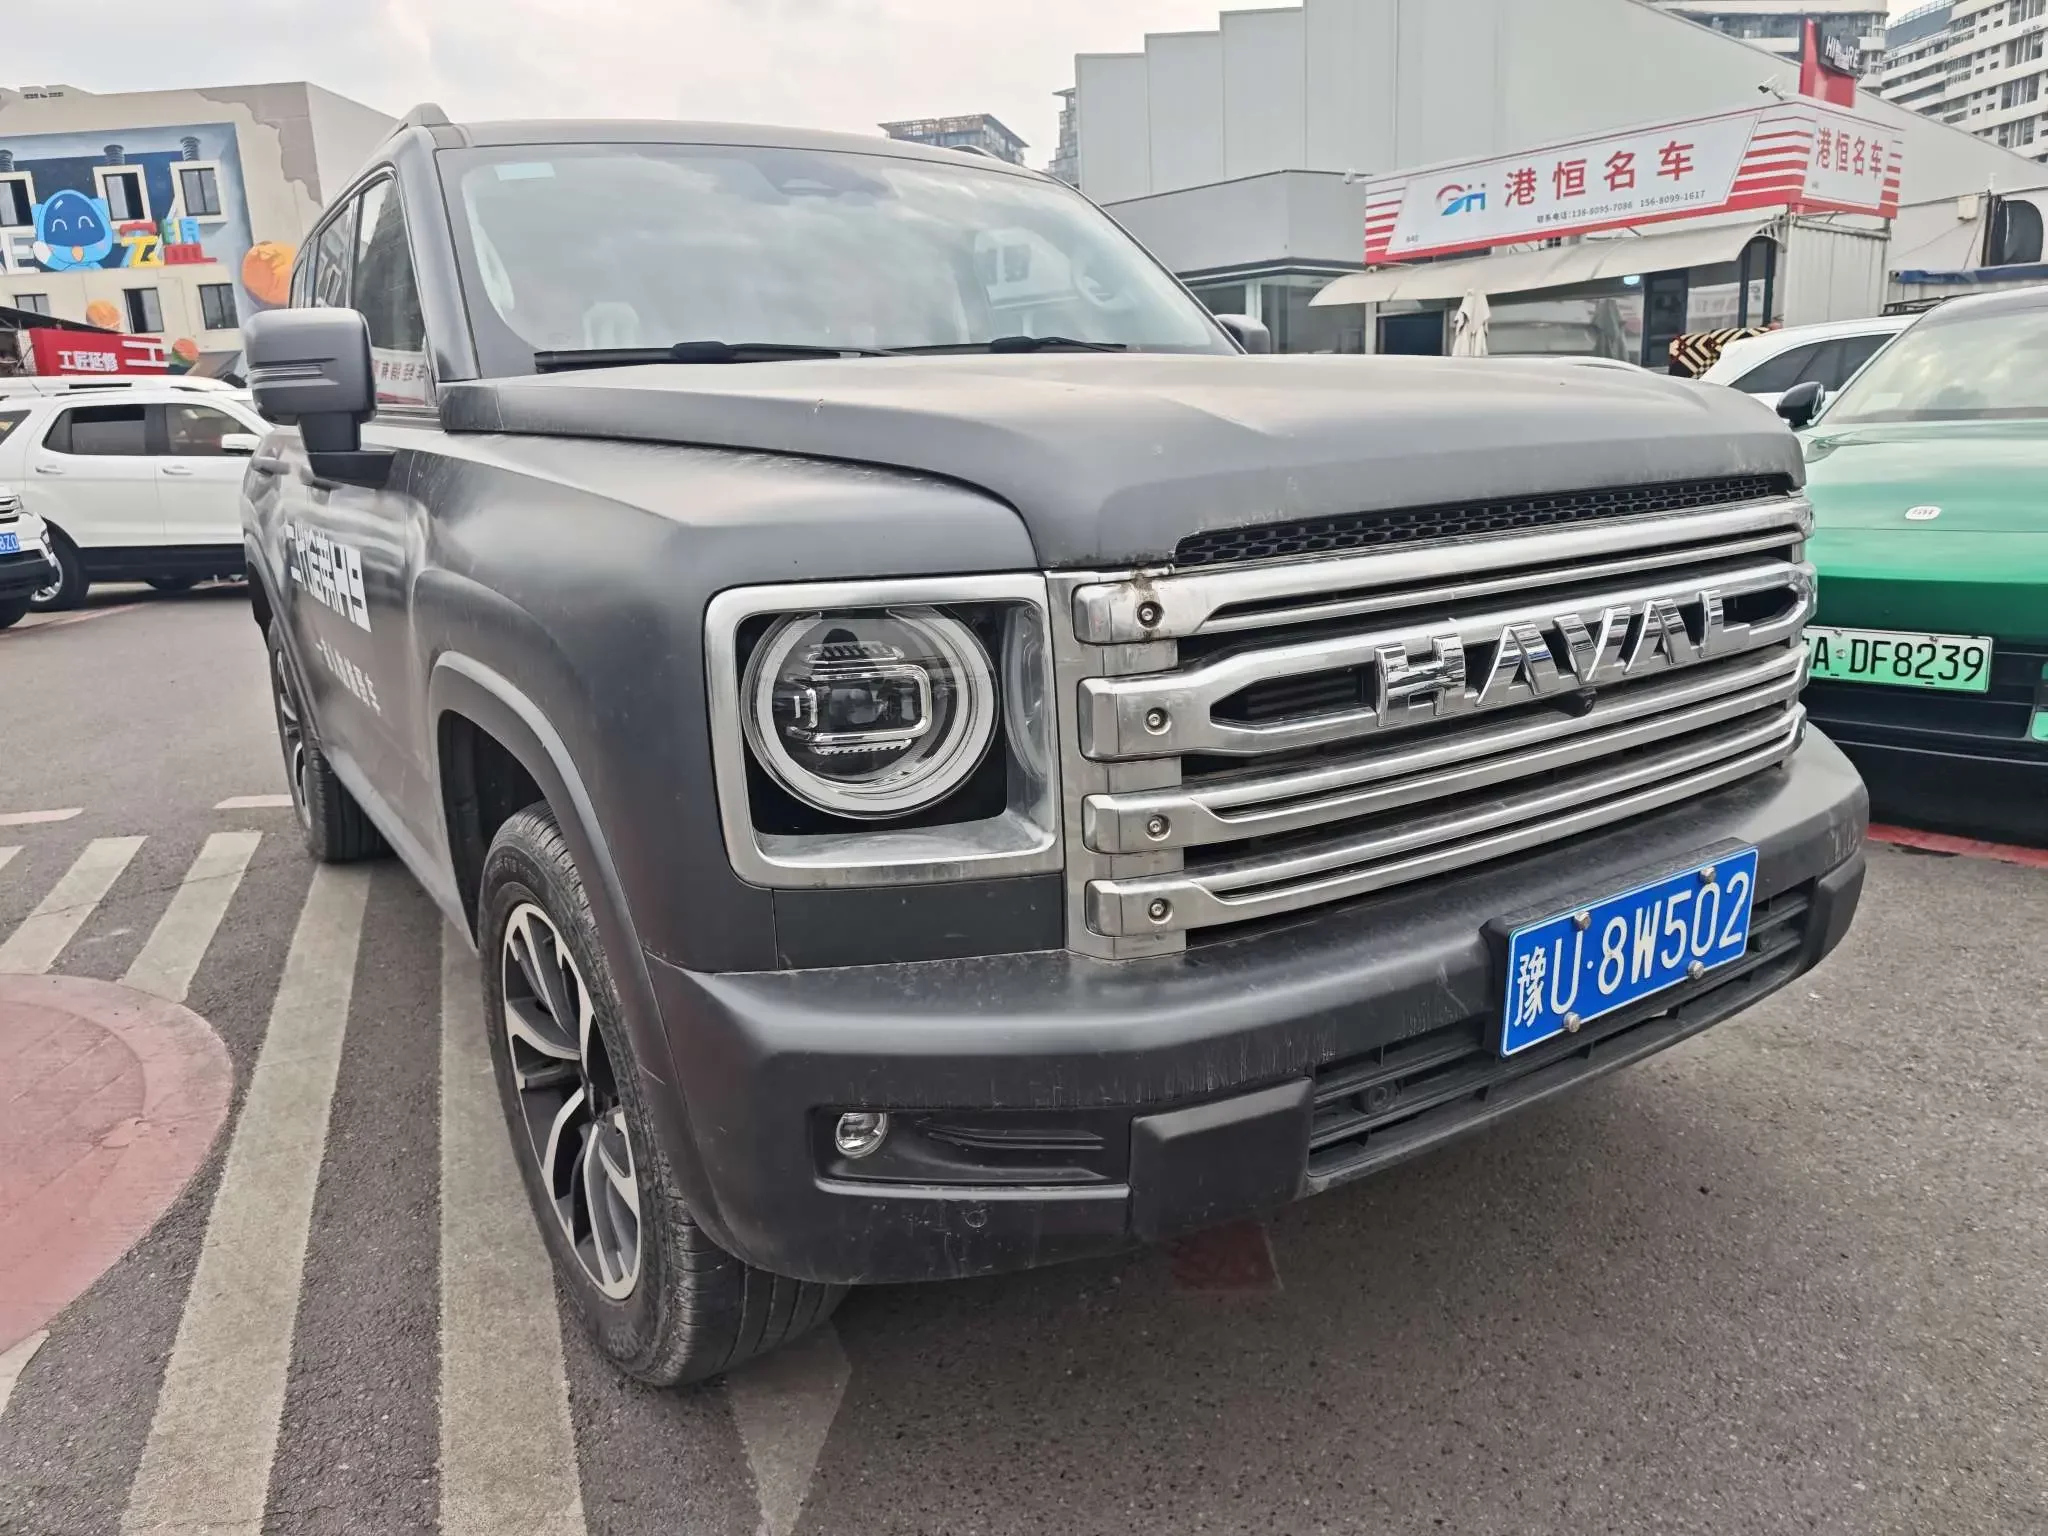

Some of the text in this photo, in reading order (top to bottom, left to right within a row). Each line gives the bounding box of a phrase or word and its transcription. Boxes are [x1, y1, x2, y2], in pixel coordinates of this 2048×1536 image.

[1504, 140, 1695, 208] 港恒名车
[1816, 127, 1883, 182] 港恒名车
[1374, 589, 1750, 727] HAVAL
[1513, 871, 1750, 1028] 豫U·8W502
